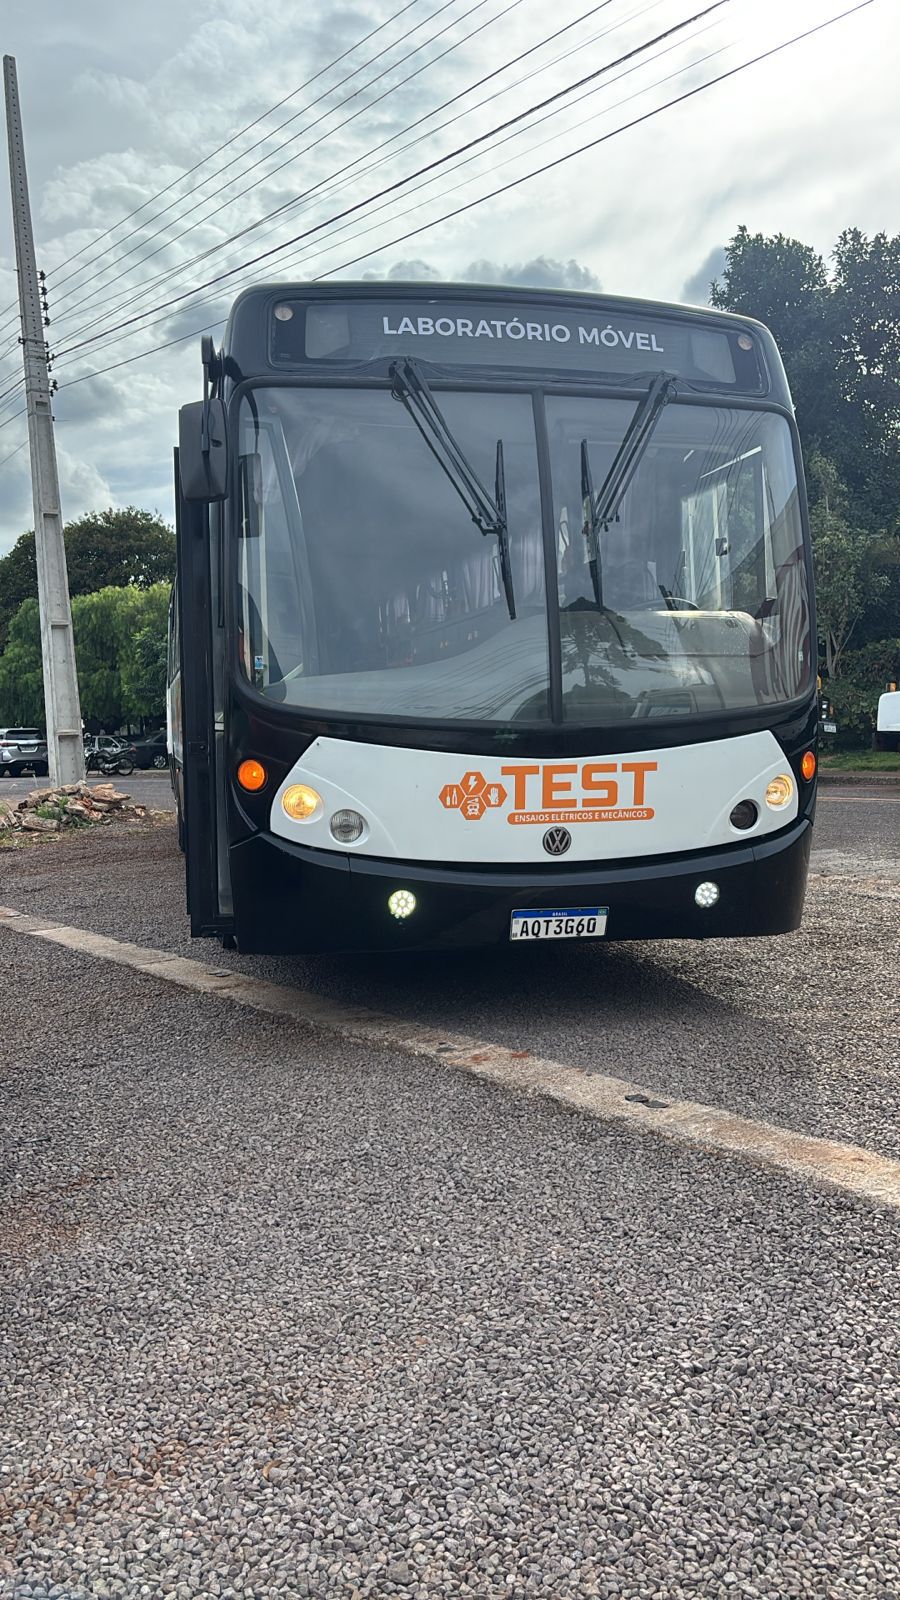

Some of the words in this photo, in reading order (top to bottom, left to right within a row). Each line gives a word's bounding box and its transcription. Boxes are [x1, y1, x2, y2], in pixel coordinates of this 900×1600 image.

[382, 316, 571, 343] LABORATÓRIO
[578, 324, 664, 353] MÓVEL
[501, 762, 658, 810] TEST
[514, 813, 550, 823] ENSAIOS
[551, 811, 593, 821] ELÉTRICOS
[594, 811, 600, 820] E
[601, 809, 648, 819] MECÂNICOS
[519, 917, 598, 938] AQT3G60
